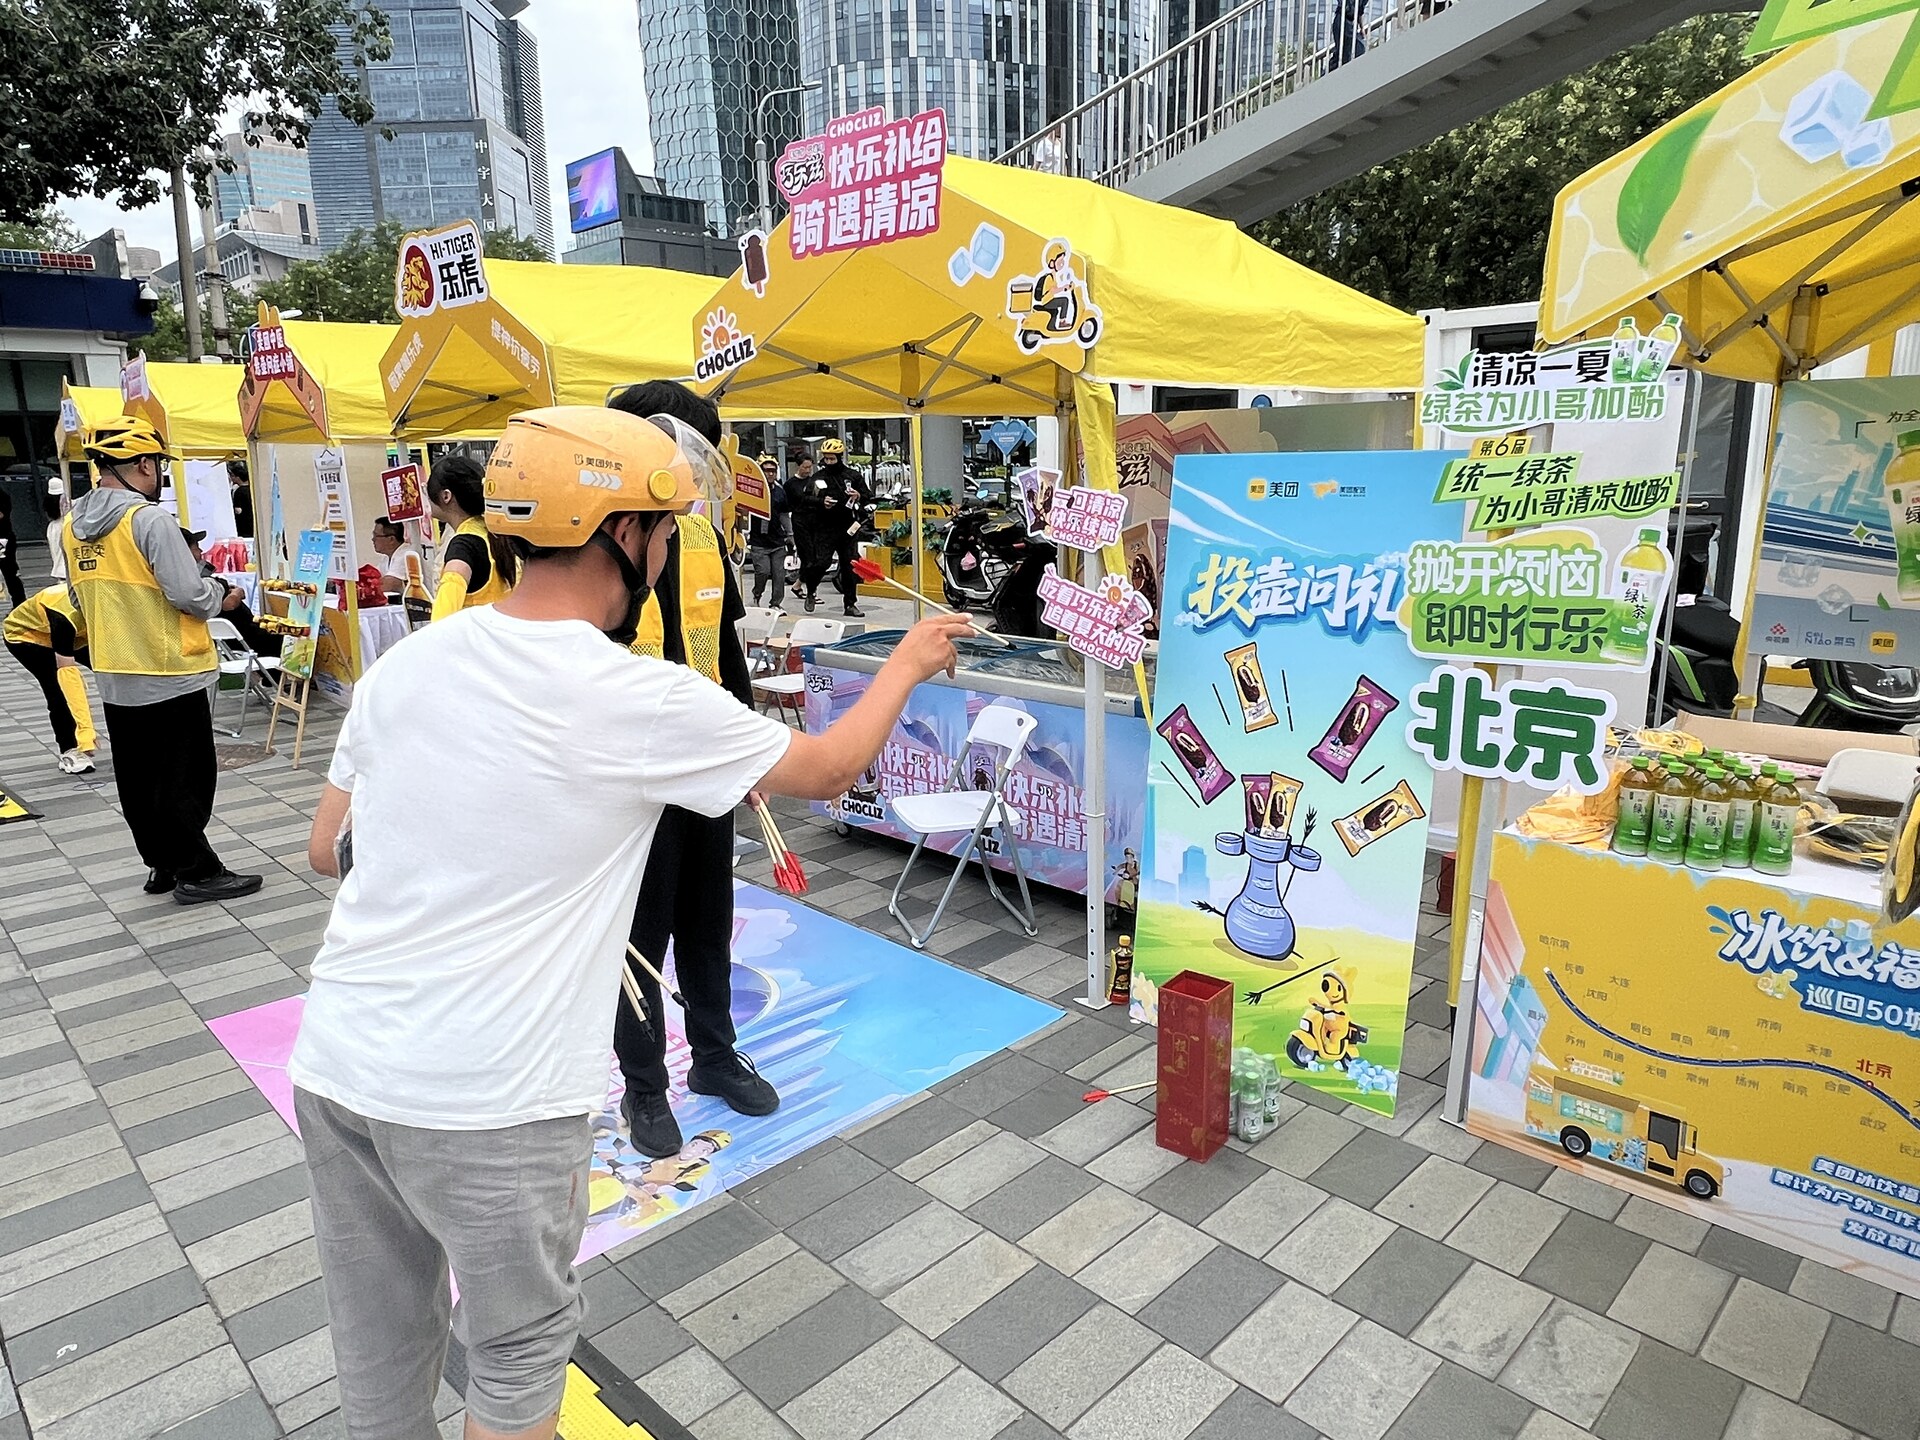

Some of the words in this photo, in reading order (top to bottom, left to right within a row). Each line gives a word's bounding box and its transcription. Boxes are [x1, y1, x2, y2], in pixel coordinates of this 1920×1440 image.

[829, 112, 881, 138] CHOCLIZ
[829, 116, 943, 190] 快乐补给
[792, 172, 939, 254] 骑遇清凉
[438, 253, 485, 301] 乐虎
[696, 338, 755, 380] CHOCLIZ
[1472, 350, 1611, 387] 清凉一夏
[1422, 384, 1665, 423] 绿茶为小哥加酚
[1886, 408, 1920, 423] 为全
[1480, 437, 1527, 456] 第6届
[585, 457, 623, 471] 美团外卖
[1449, 456, 1577, 493] 统一绿茶
[1269, 481, 1299, 498] 美团
[1483, 476, 1674, 525] 为小哥清凉加酚
[1055, 491, 1124, 520] 一口清凉
[1050, 507, 1118, 542] 快乐续航
[1052, 530, 1096, 549] CHOCLIZ
[1412, 548, 1598, 598] 抛开烦恼
[1041, 577, 1121, 627] 吃着巧乐兹
[1188, 554, 1399, 631] 投壶问礼
[1045, 604, 1142, 661] 追着夏天的风
[1426, 603, 1608, 654] 即时行乐
[1071, 638, 1122, 666] CHOCLIZ
[1872, 638, 1894, 647] 美团
[1413, 674, 1607, 786] 北京
[880, 741, 968, 787] 快乐补
[1004, 770, 1087, 820] 快乐补
[842, 799, 884, 820] CHOCLIZ
[1564, 962, 1584, 975] 长春
[1609, 975, 1631, 988] 大连
[1630, 1022, 1652, 1036] 烟台
[1756, 1017, 1782, 1033] 济南
[1565, 1034, 1586, 1048] 苏州
[1670, 1032, 1693, 1046] 青岛
[1806, 1043, 1833, 1058] 天津
[1603, 1049, 1624, 1063] 南通
[1856, 1058, 1893, 1079] 北京
[1686, 1072, 1710, 1087] 常州
[1735, 1075, 1760, 1090] 扬州
[1782, 1081, 1808, 1097] 南京
[1824, 1081, 1851, 1095] 合肥
[1859, 1115, 1887, 1131] 武汉
[1815, 1158, 1920, 1203] 美团冰饮福
[1773, 1170, 1920, 1231] 累计为户外工作
